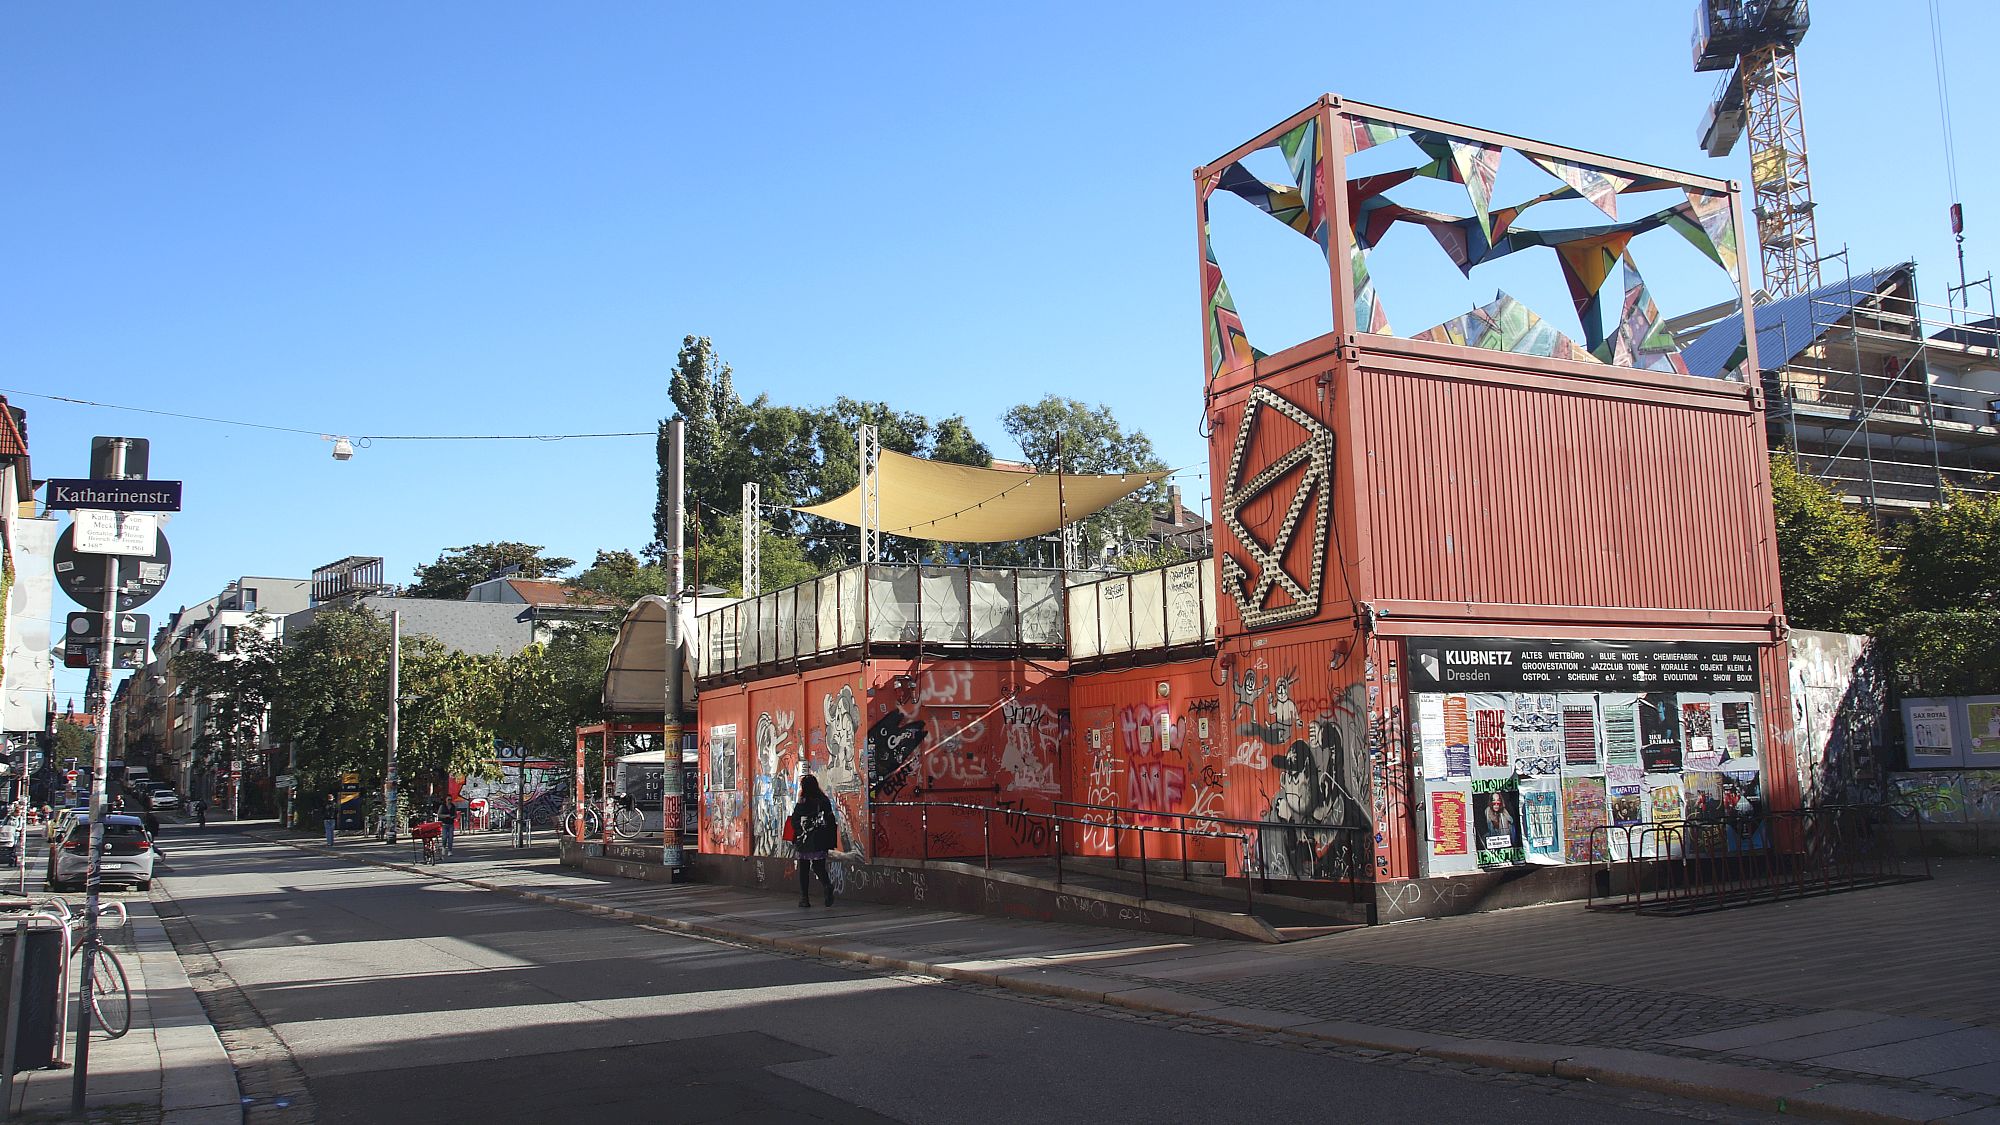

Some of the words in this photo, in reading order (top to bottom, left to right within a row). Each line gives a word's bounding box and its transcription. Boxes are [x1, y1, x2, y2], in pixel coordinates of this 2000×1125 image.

[56, 486, 173, 504] Katharinenstr.
[1445, 650, 1513, 665] KLUBNETZ
[1521, 651, 1543, 660] ALTES
[1548, 651, 1585, 660] WETTBÜRO
[1599, 652, 1616, 661] BLUE
[1622, 653, 1639, 661] NOTE
[1653, 653, 1699, 661] CHEMIEFABRIK
[1711, 654, 1728, 662] CLUB
[1732, 654, 1752, 662] PAULA
[1522, 662, 1579, 671] GROOVESTATION
[1590, 663, 1624, 671] JAZZCLUB
[1627, 663, 1649, 671] TONNE
[1660, 663, 1689, 671] KORALLE
[1700, 664, 1723, 672] OBJEKT
[1727, 664, 1744, 672] KLEIN
[1747, 664, 1752, 672] A
[1447, 668, 1491, 681] Dresden
[1522, 673, 1551, 681] OSTPOL
[1567, 673, 1599, 681] SCHEUNE
[1605, 673, 1616, 681] e.V.
[1632, 673, 1657, 682] SETOR
[1663, 673, 1698, 681] EVOLUTION
[1712, 673, 1731, 682] SHOW
[1736, 673, 1753, 682] BOXX
[1927, 711, 1947, 719] ROYAL
[1381, 883, 1421, 915] XD
